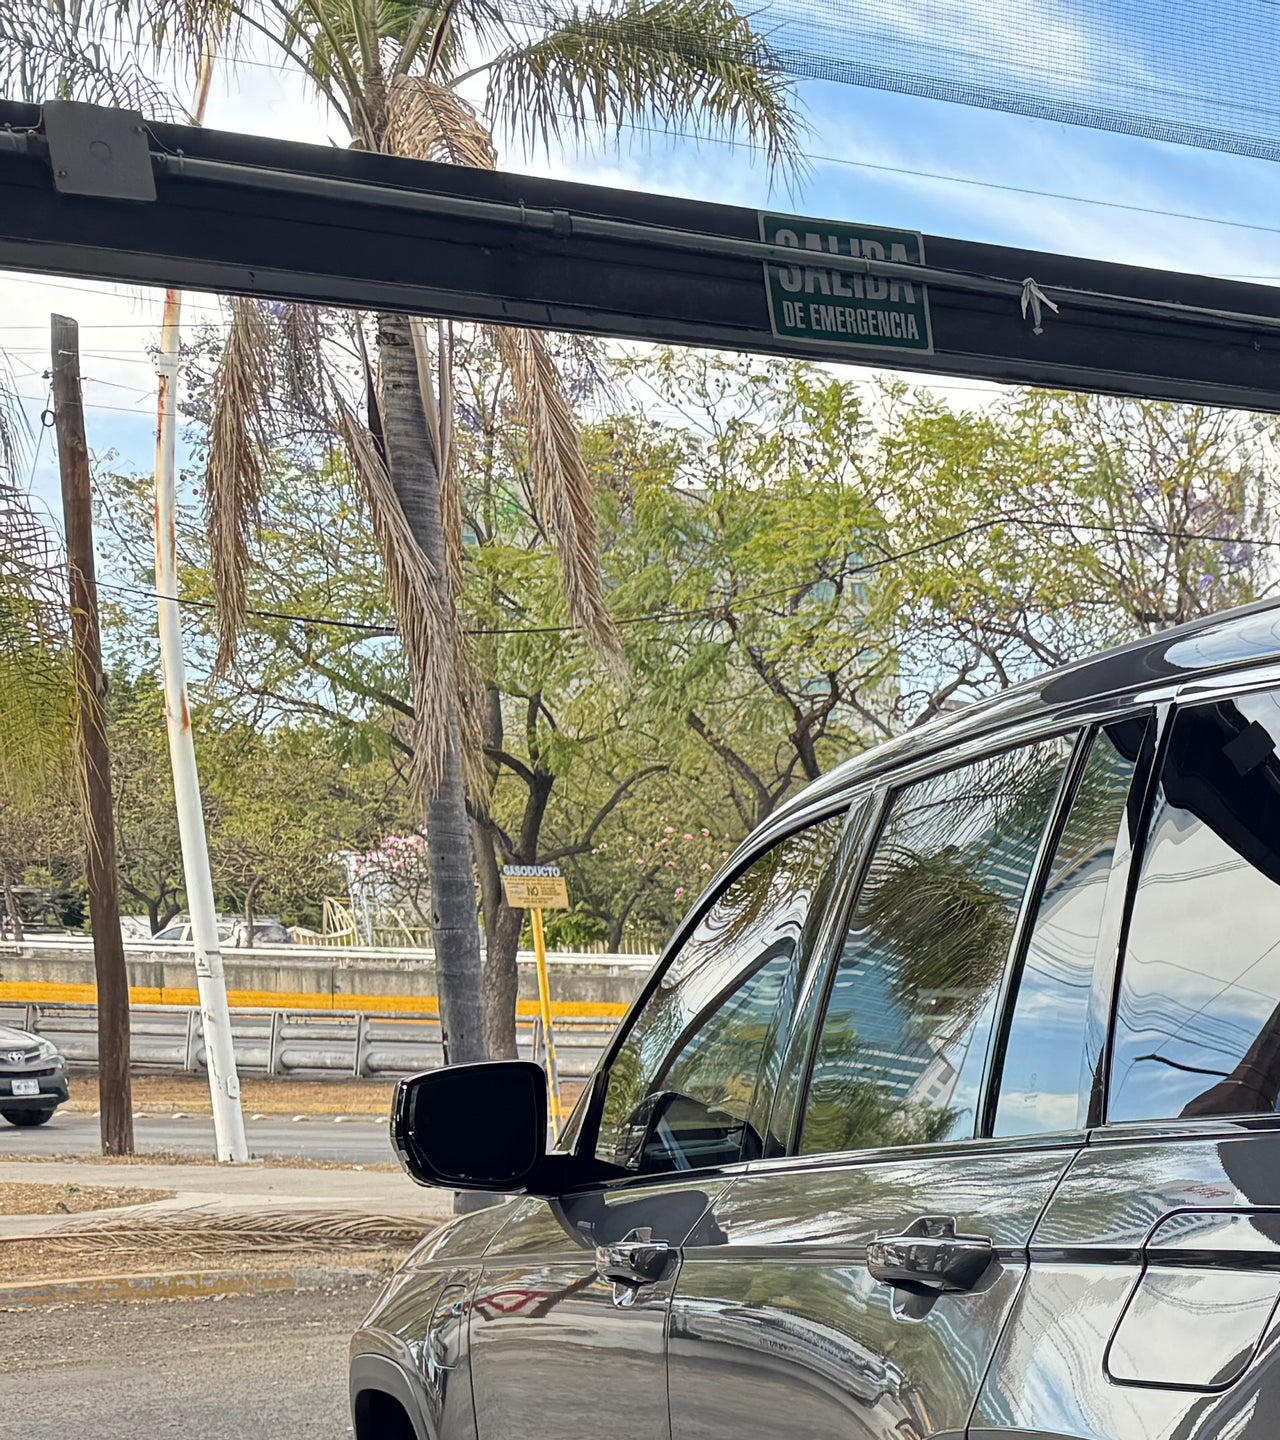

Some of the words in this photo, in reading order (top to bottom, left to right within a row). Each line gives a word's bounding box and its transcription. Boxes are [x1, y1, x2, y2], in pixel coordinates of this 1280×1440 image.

[775, 228, 916, 304] SALIDA
[783, 300, 806, 329] DE
[809, 304, 920, 340] EMERGENCIA
[504, 865, 560, 877] GASODUCTO
[527, 886, 539, 896] NO
